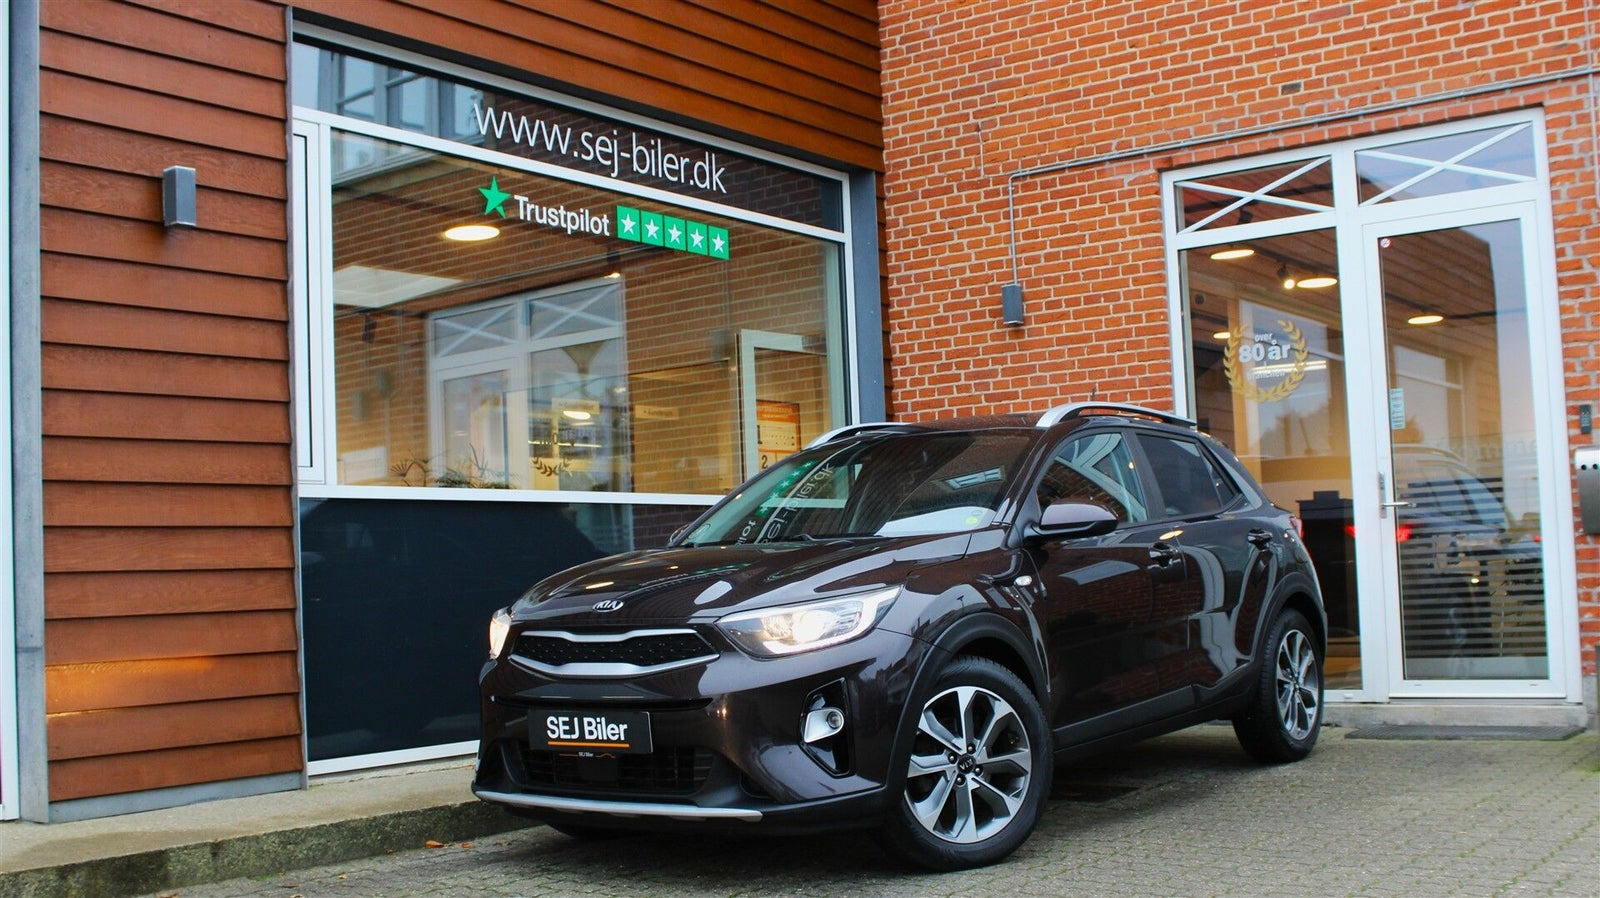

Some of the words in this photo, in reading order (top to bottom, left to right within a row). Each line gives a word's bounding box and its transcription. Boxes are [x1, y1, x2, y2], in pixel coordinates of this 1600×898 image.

[473, 103, 727, 194] www.sej-biler.dk
[514, 194, 610, 236] Trustpilot
[1254, 332, 1273, 343] over
[1239, 343, 1266, 363] 80
[1267, 339, 1291, 361] år
[761, 455, 769, 469] 2
[546, 716, 580, 740] SEJ
[583, 717, 628, 742] Biler
